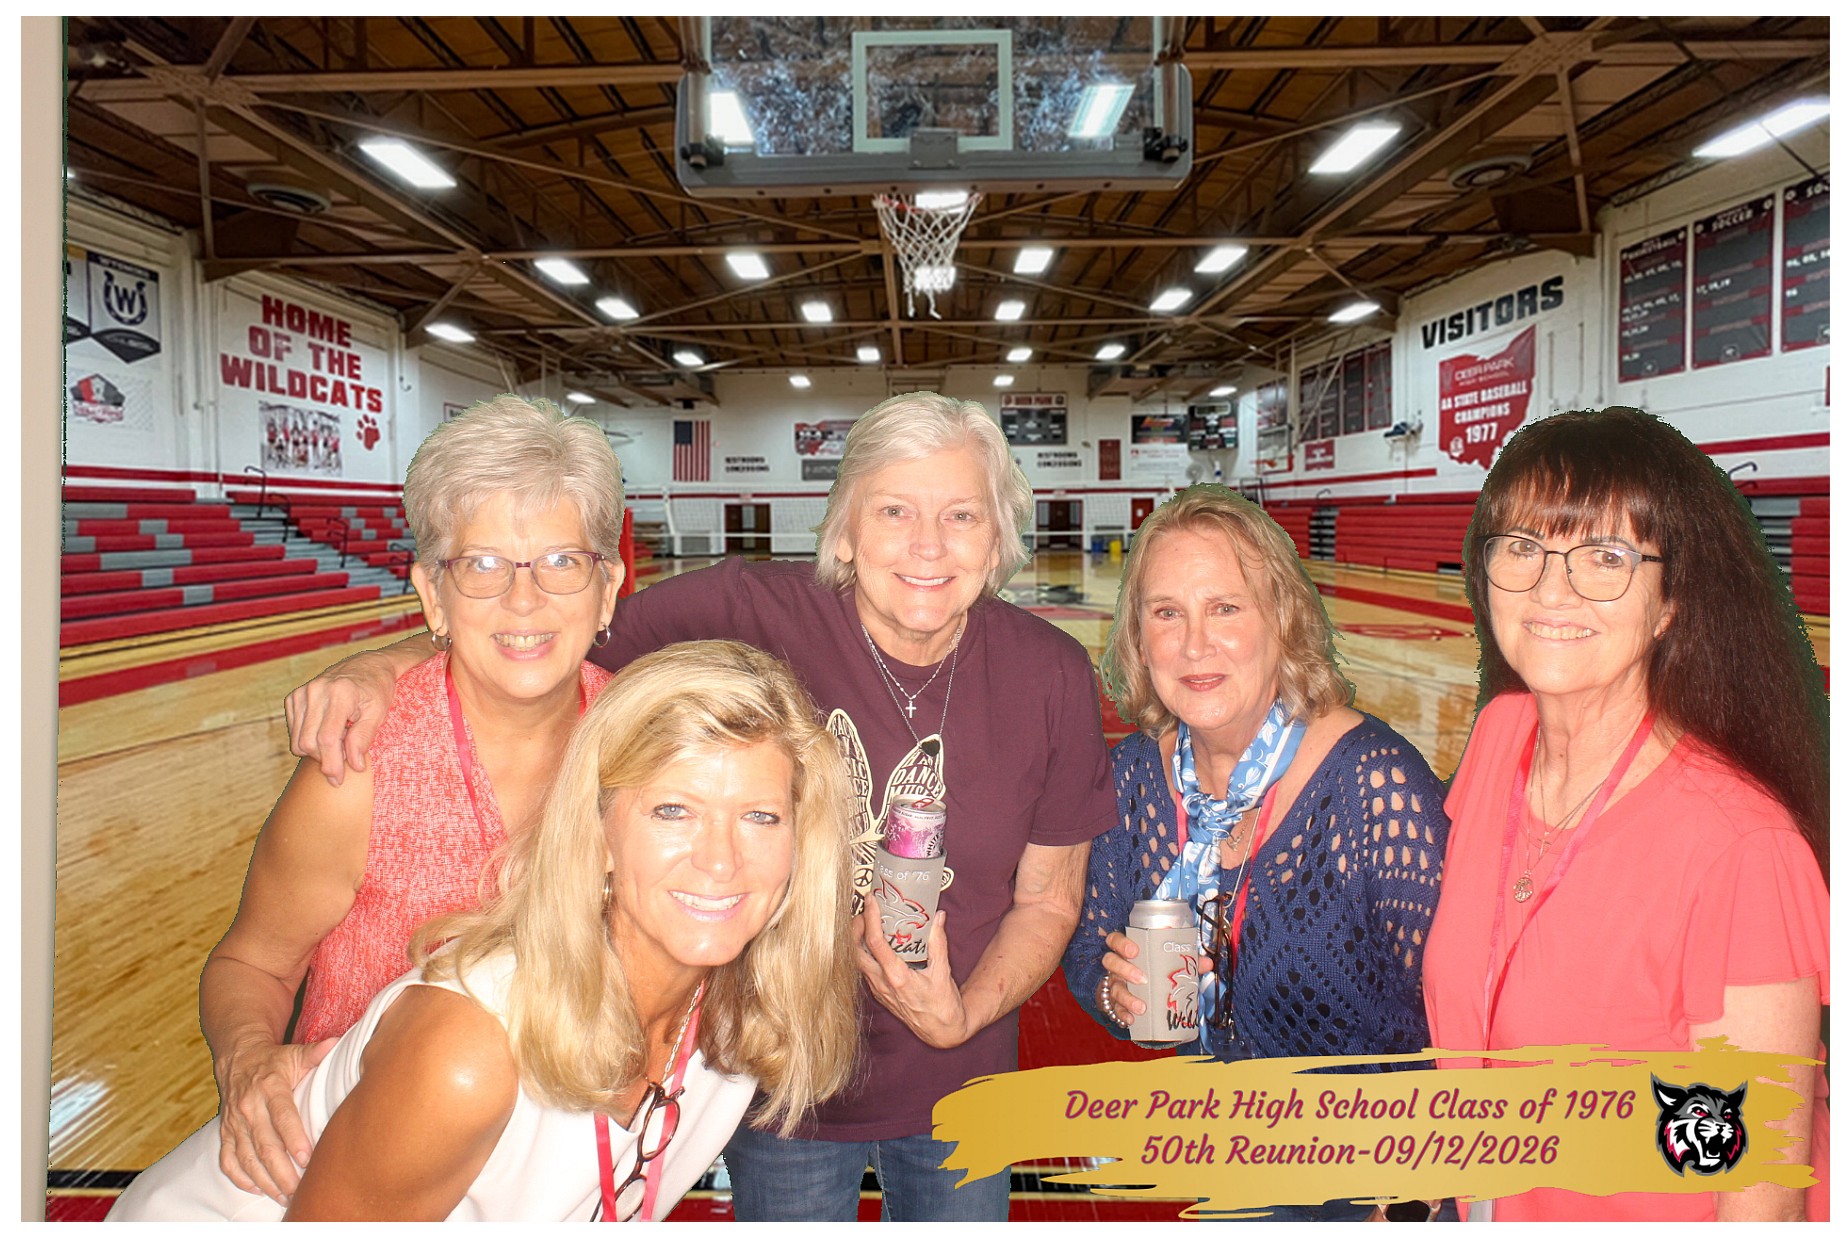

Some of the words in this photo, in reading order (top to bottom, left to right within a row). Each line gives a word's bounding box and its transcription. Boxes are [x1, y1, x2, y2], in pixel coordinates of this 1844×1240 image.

[114, 284, 136, 314] W
[1422, 275, 1563, 349] VISITORS
[262, 294, 352, 348] HOME
[249, 325, 292, 361] OF
[307, 341, 361, 380] THE
[220, 352, 382, 414] WILDCATS
[1454, 364, 1482, 381] DEER
[1483, 356, 1514, 373] PARK
[1441, 397, 1453, 411] AA
[1454, 391, 1479, 408] STATE
[1481, 380, 1527, 402] BASEBALL
[1455, 402, 1510, 424] CHAMPIONS
[1465, 422, 1497, 444] 1977
[892, 766, 941, 798] DANCE
[897, 870, 908, 881] of
[1163, 941, 1191, 953] Class
